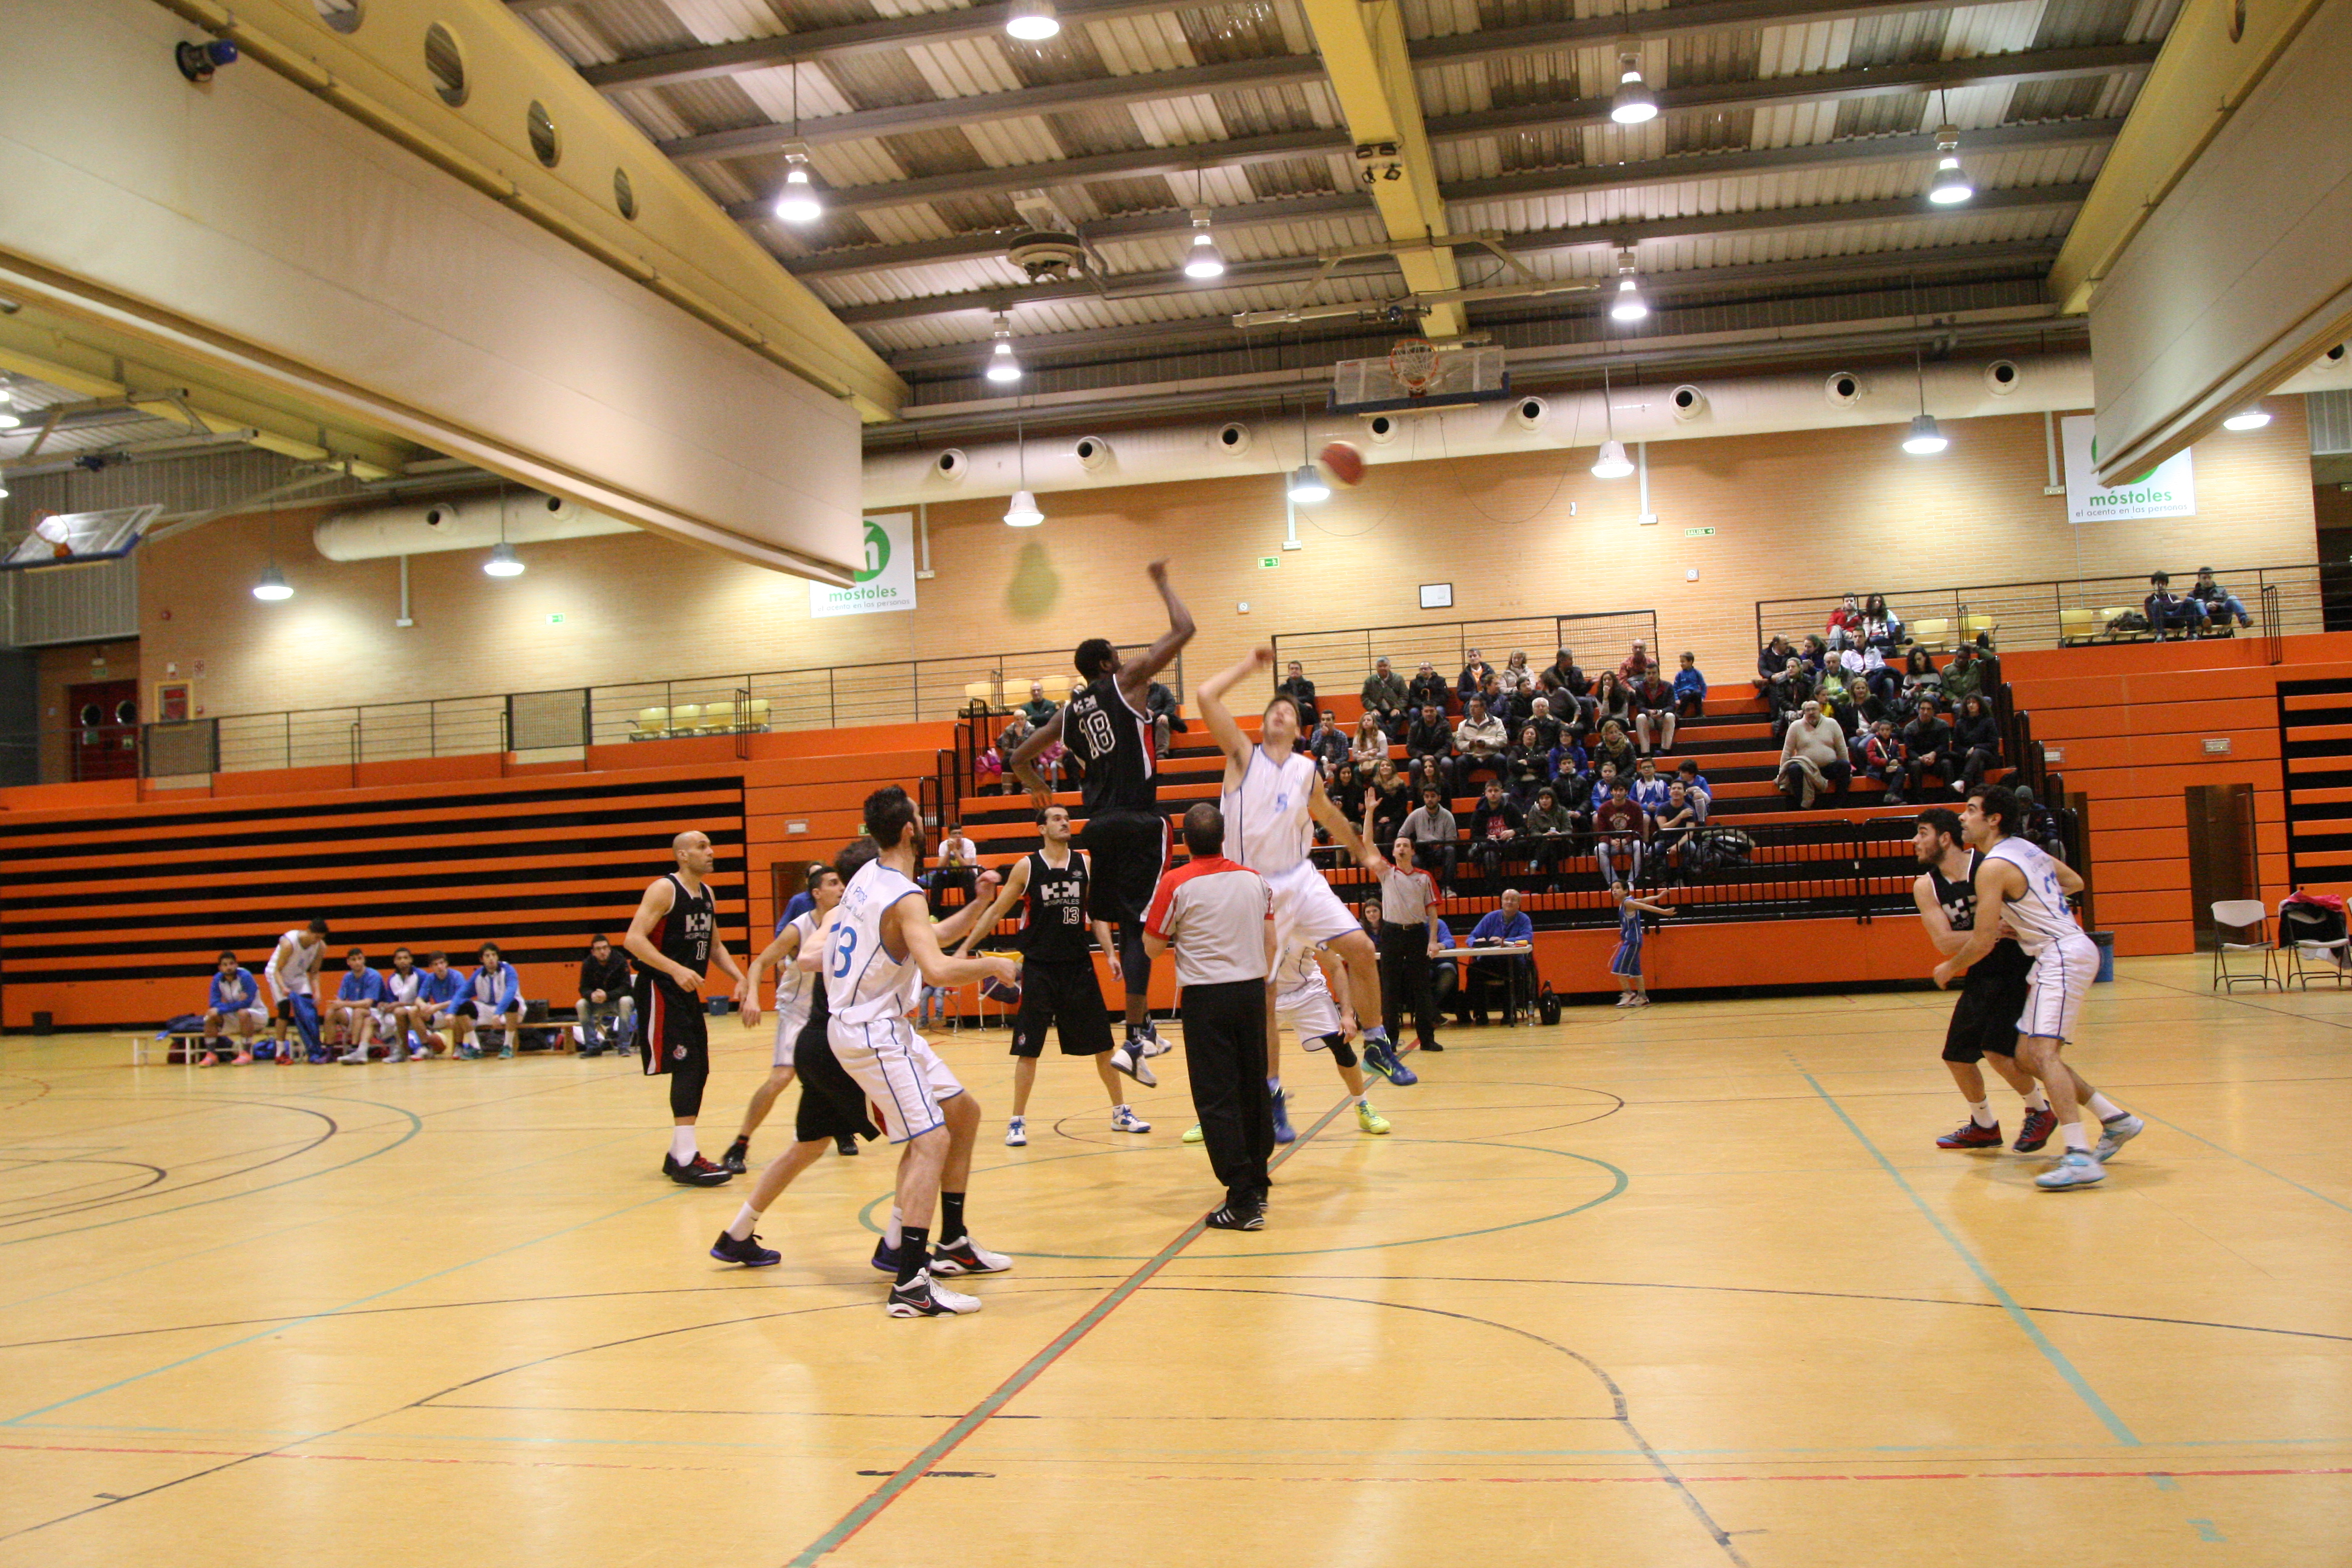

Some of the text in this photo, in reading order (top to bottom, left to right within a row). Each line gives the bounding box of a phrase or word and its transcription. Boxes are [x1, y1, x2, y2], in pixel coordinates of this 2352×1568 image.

[2089, 488, 2172, 506] móstoles
[2087, 508, 2115, 517] acento
[2148, 504, 2187, 514] personas
[877, 599, 910, 607] personas
[1079, 710, 1116, 759] 18
[1044, 898, 1080, 907] HOSPITALES
[1063, 906, 1079, 924] 13
